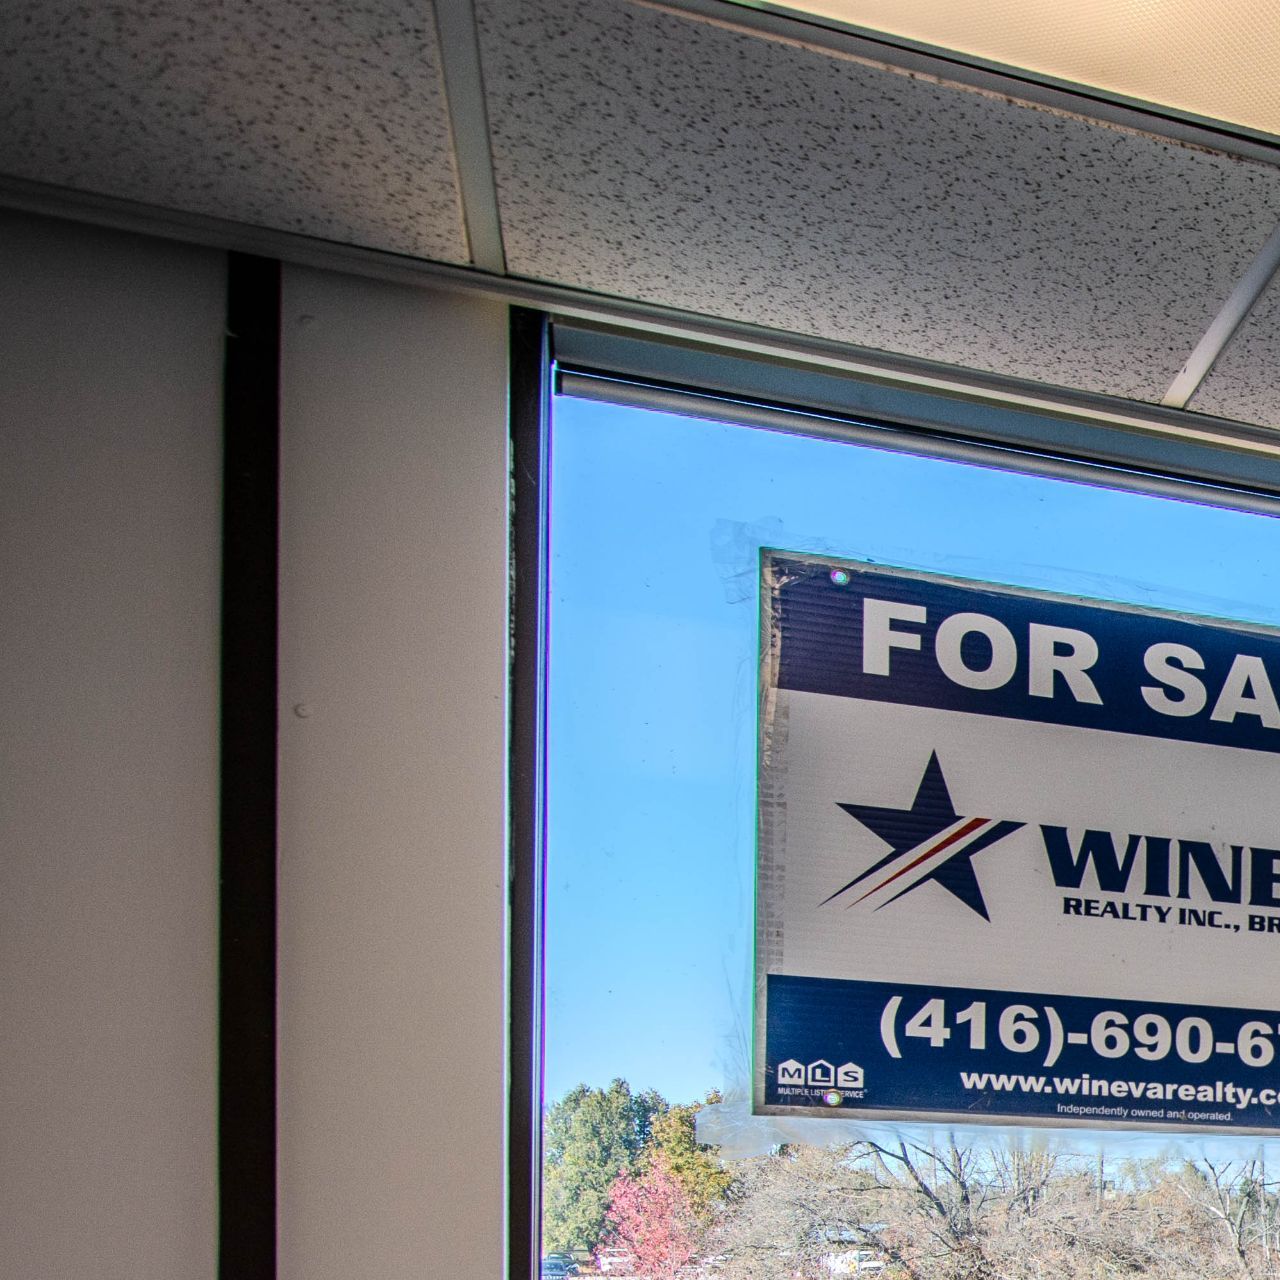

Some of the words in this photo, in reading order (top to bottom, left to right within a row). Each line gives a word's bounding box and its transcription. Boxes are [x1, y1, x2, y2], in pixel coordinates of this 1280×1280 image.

[863, 598, 1103, 705] FOR
[1063, 897, 1172, 923] REALTY
[1178, 908, 1240, 933] INC.,
[1057, 1104, 1128, 1117] Independently
[1131, 1109, 1163, 1118] owned
[1167, 1110, 1184, 1119] and
